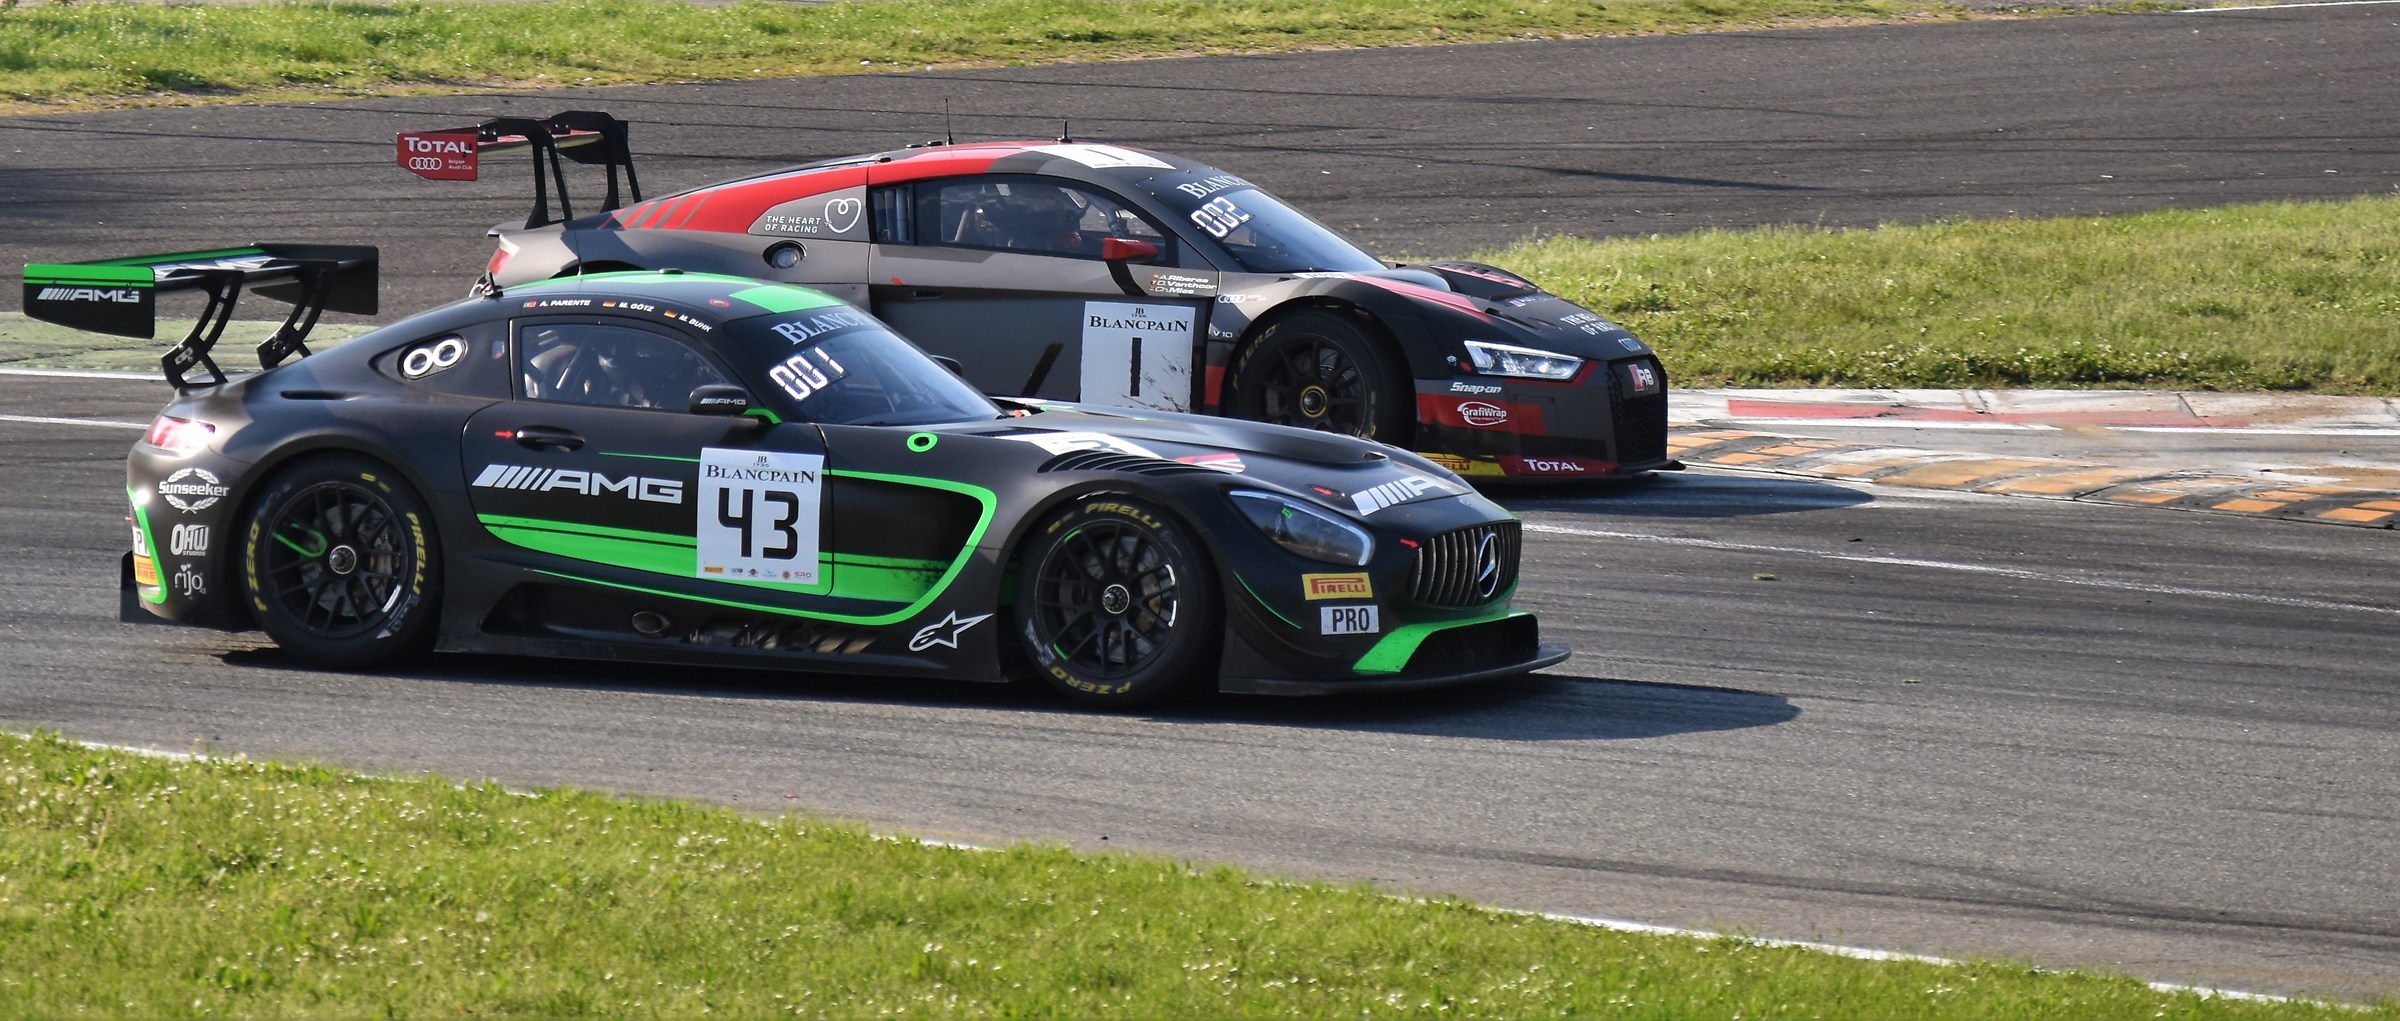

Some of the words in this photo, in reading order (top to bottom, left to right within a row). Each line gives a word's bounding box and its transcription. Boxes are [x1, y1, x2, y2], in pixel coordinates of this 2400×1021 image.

[404, 137, 473, 153] TOTAL
[766, 215, 785, 224] THE
[788, 216, 821, 225] HEART
[1191, 196, 1250, 238] 002
[765, 223, 778, 231] OF
[780, 224, 819, 234] RACING
[550, 299, 591, 307] PARENTE
[629, 302, 655, 312] GÖTZ
[678, 314, 688, 322] M.
[688, 318, 712, 332] BUHK
[1089, 315, 1188, 332] BLANCPAIN
[769, 346, 844, 401] 001
[1130, 337, 1142, 397] 1
[1636, 368, 1654, 387] R8
[1450, 382, 1502, 395] Snap-on
[1462, 407, 1507, 419] GrafiWrap
[1523, 458, 1584, 472] TOTAL
[706, 464, 815, 484] BLANCPAIN
[158, 480, 230, 497] Sunseeker
[718, 487, 800, 560] 43
[1084, 501, 1163, 530] PIRELLI
[405, 511, 427, 596] PIRELLI
[1310, 577, 1367, 594] PIRELLI
[1332, 607, 1370, 633] PRO
